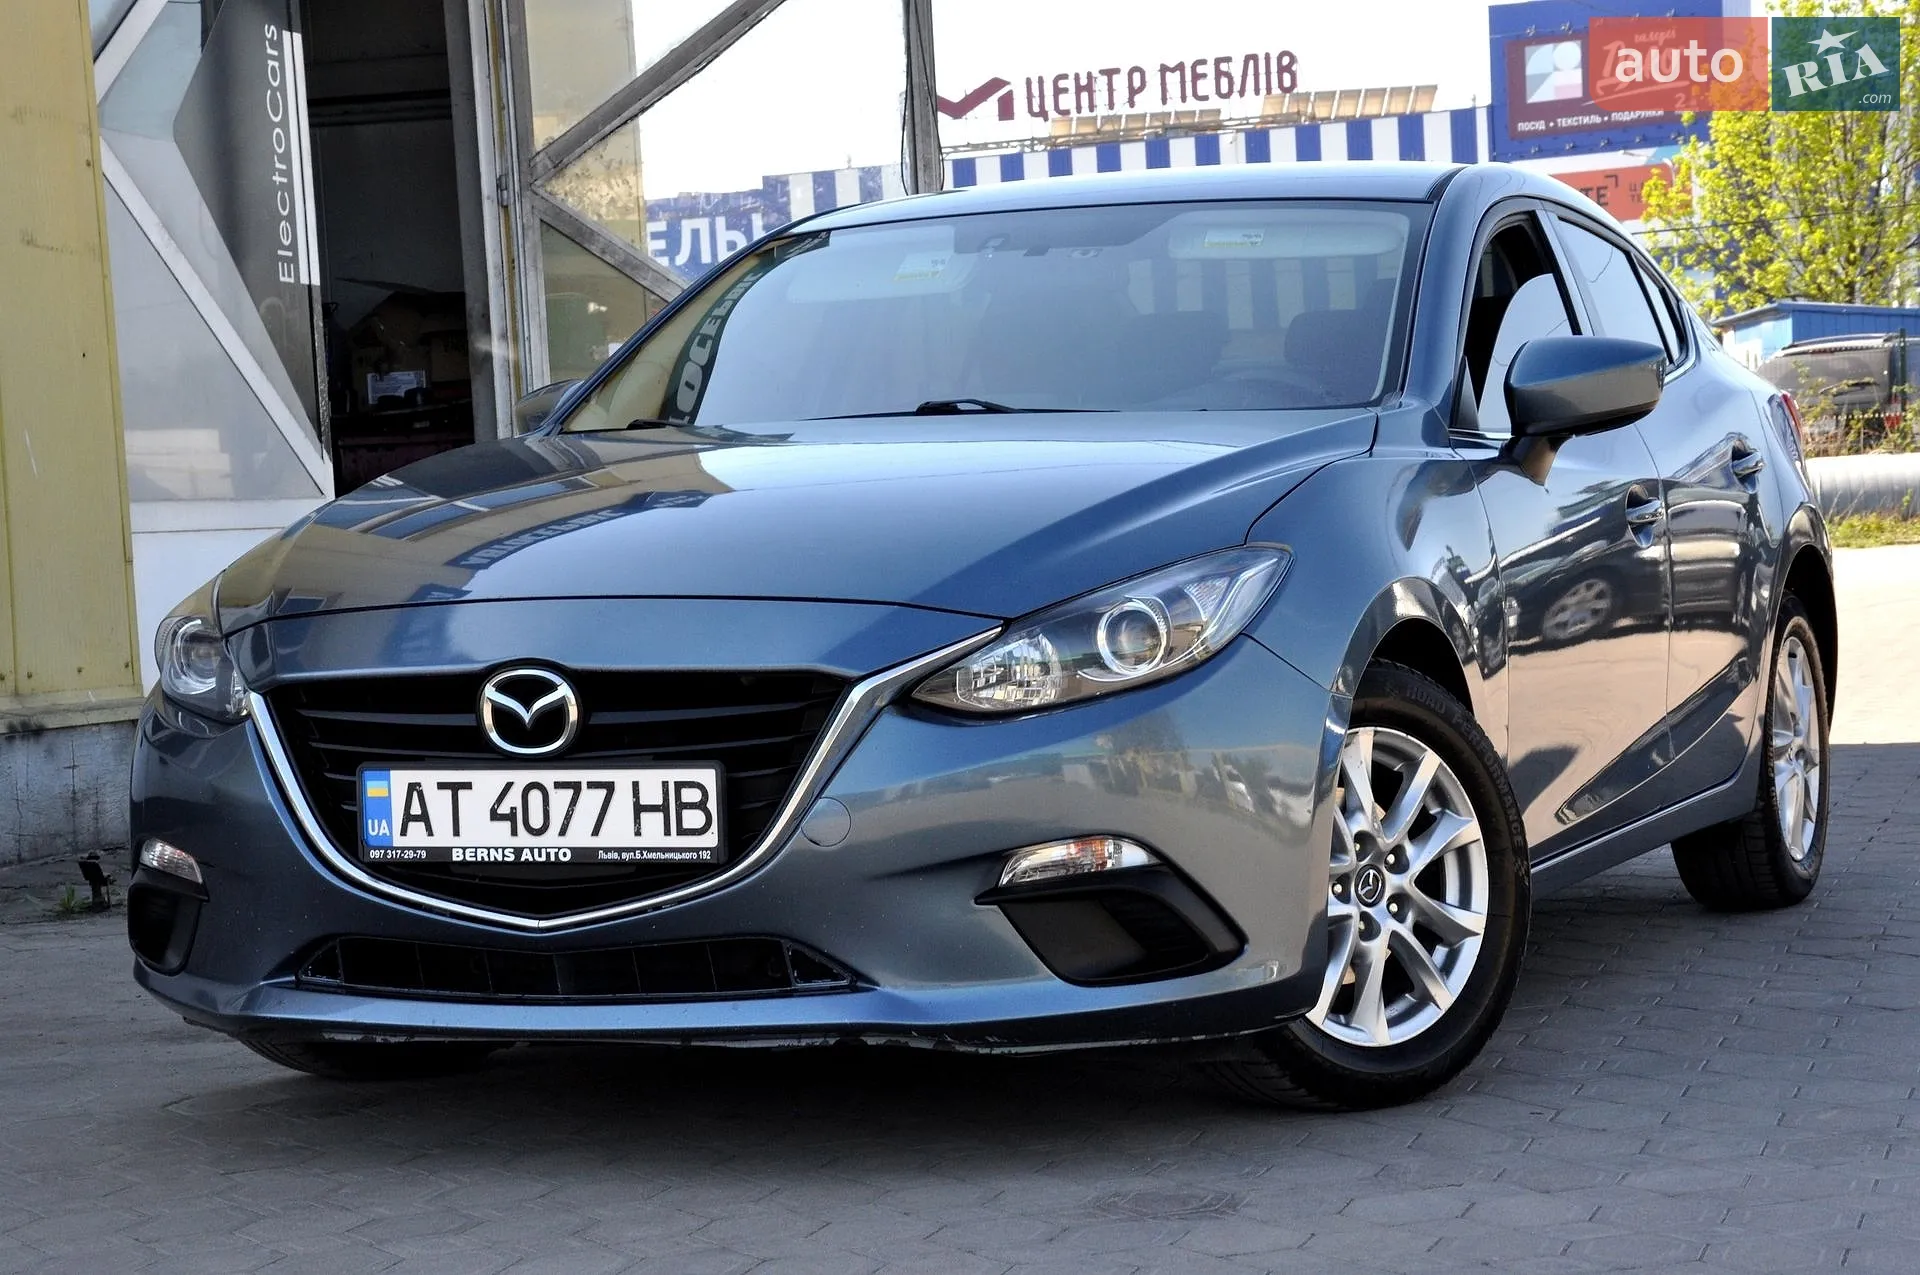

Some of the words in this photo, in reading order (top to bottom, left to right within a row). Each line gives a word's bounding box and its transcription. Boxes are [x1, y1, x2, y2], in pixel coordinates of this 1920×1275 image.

[1026, 66, 1147, 122] ЦЕНТР
[1159, 50, 1299, 106] МЕБЛІВ
[1517, 120, 1546, 131] ПОСУД
[1556, 114, 1602, 128] ТЕКСТИЛЬ
[264, 23, 295, 284] ElectroCars
[400, 781, 473, 837] AT
[489, 780, 616, 837] 4077
[631, 780, 713, 837] HB
[368, 819, 390, 836] UA
[369, 849, 385, 859] 097
[386, 849, 427, 859] 317-29-79
[452, 848, 515, 862] BERNS
[519, 848, 572, 862] AUTO
[698, 850, 711, 860] 192
